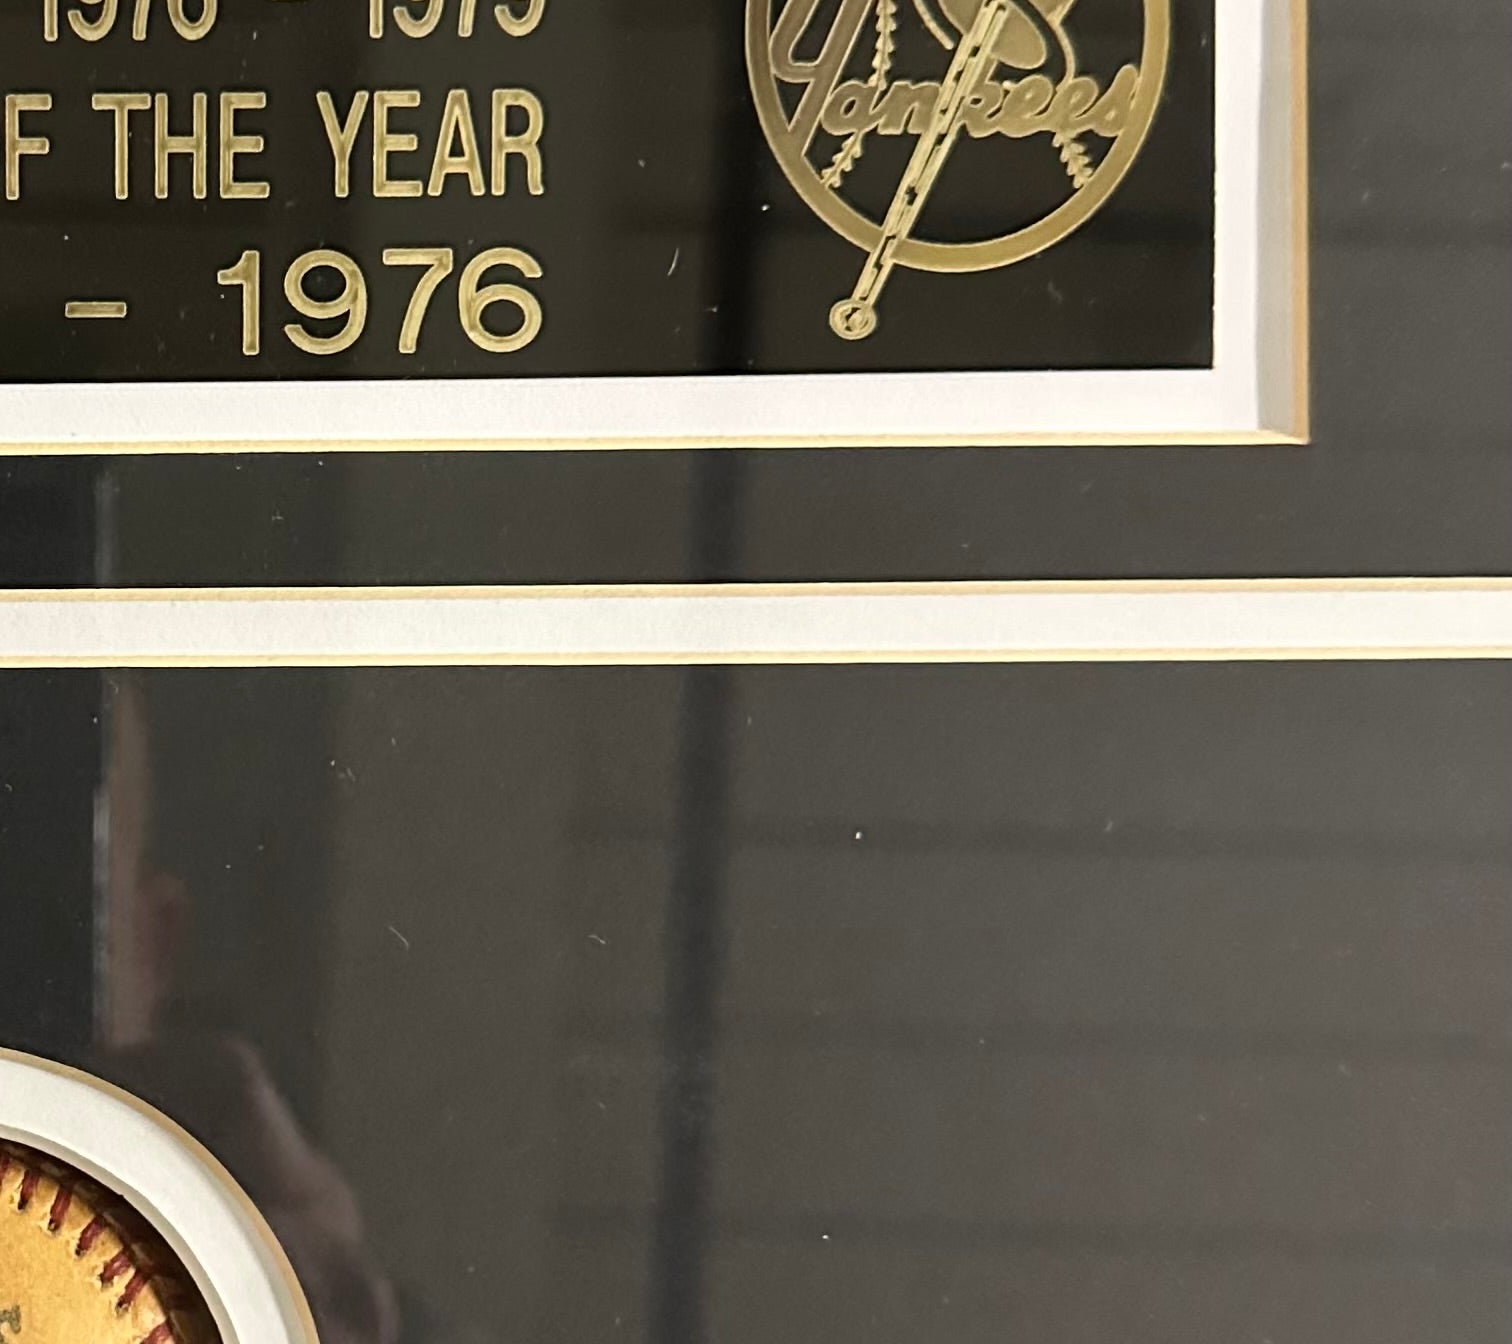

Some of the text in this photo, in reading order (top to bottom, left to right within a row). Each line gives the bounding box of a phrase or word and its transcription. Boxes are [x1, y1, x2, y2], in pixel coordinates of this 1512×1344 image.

[91, 91, 271, 201] THE
[315, 87, 545, 198] YEAR
[216, 246, 544, 356] 1976
